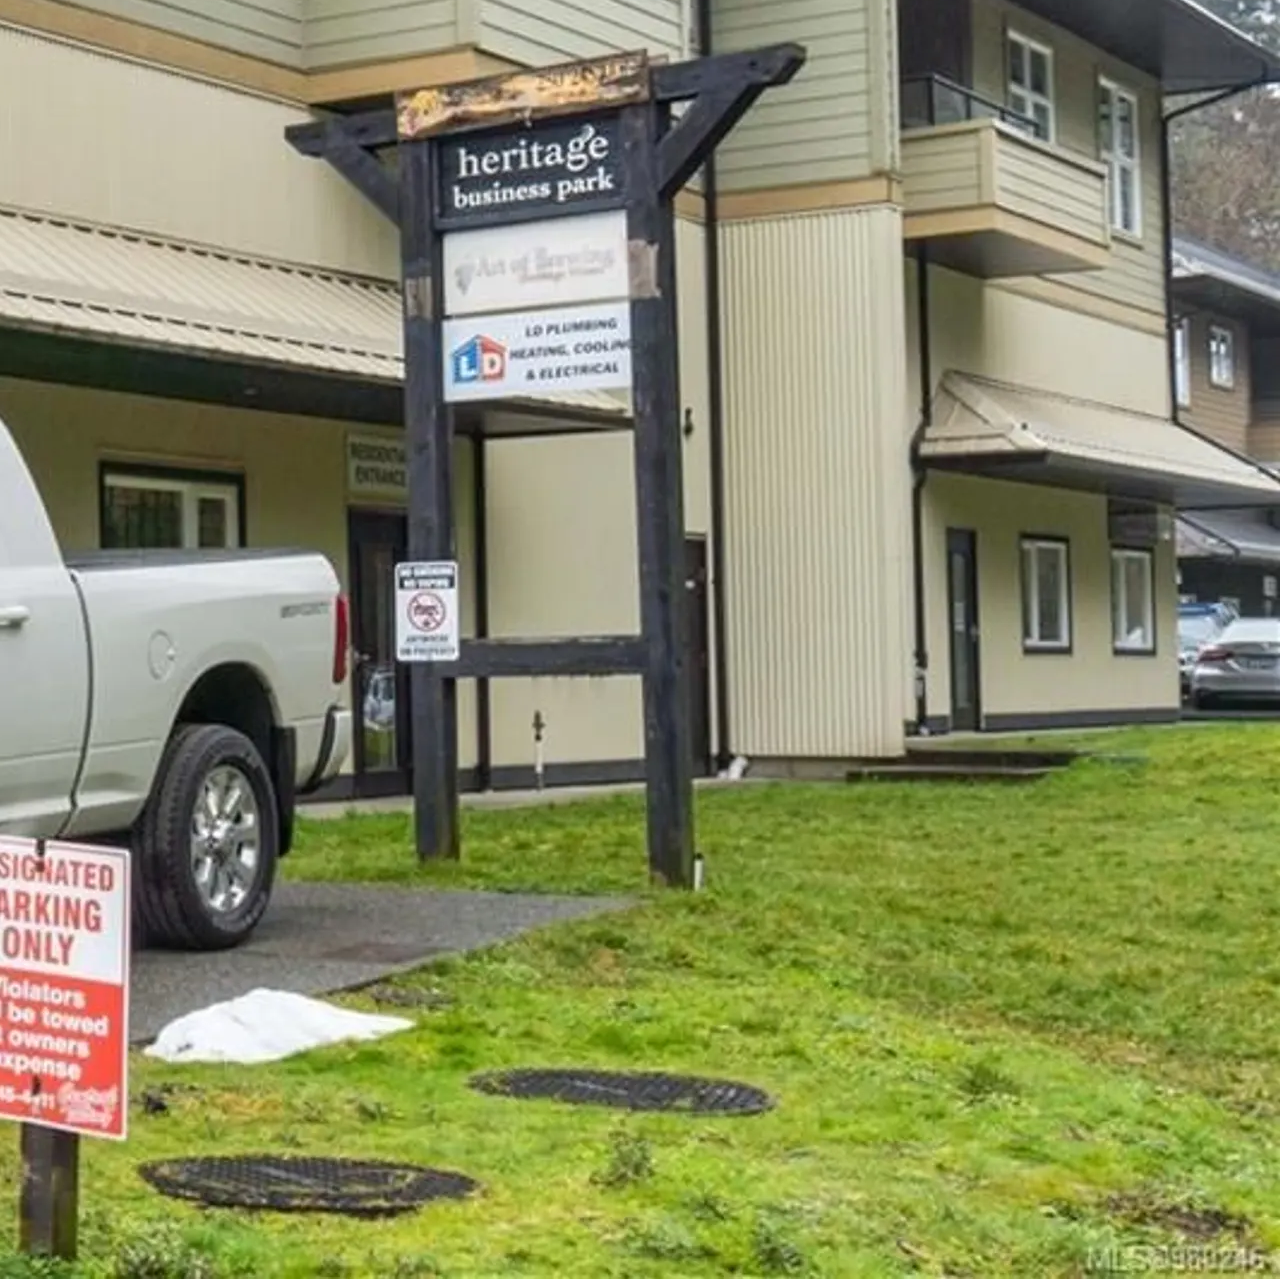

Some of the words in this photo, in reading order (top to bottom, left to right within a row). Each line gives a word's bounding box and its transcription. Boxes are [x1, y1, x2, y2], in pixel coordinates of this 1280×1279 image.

[457, 125, 609, 178] heritage
[452, 180, 552, 209] business
[557, 166, 614, 201] park
[525, 326, 543, 338] LD
[546, 318, 618, 336] PLUMBING
[539, 362, 619, 380] ELECTRICAL
[2, 925, 75, 966] ONLY
[7, 1001, 36, 1025] be
[42, 1006, 110, 1038] towed
[8, 1029, 90, 1059] owners
